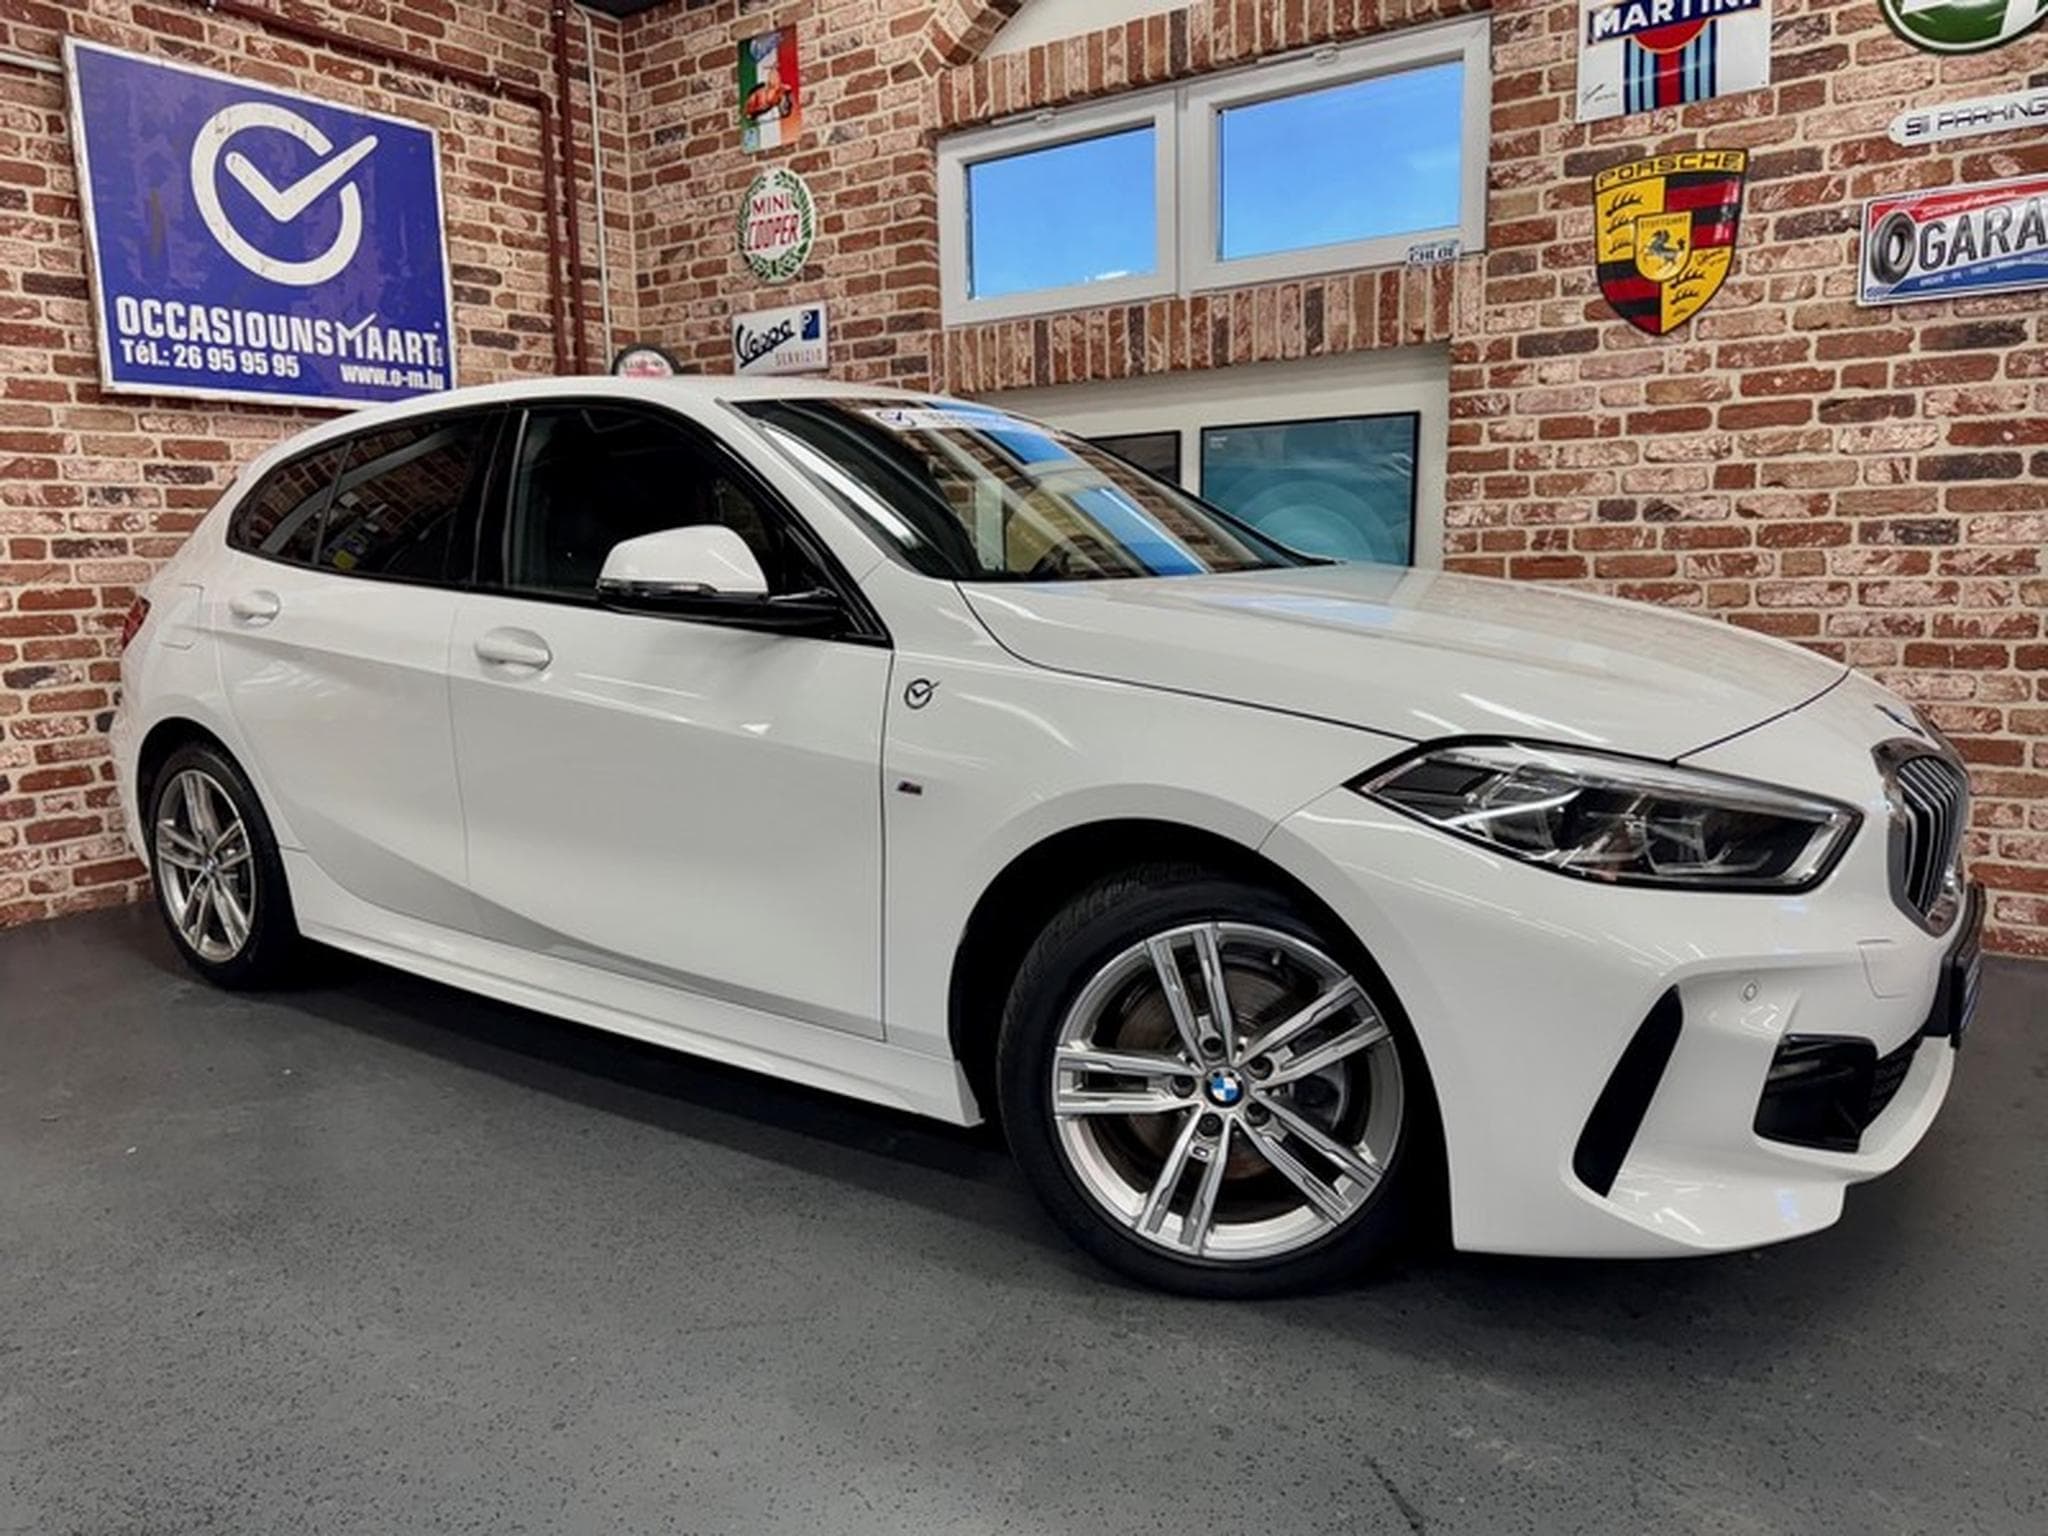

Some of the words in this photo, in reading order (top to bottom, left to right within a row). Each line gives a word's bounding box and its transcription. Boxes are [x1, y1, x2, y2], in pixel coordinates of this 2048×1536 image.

[1593, 0, 1752, 38] MARTI
[1599, 153, 1740, 188] PORSCHE
[752, 192, 791, 216] MINI
[746, 213, 800, 251] COOPER
[115, 295, 439, 367] OCCASIOUNSMAART
[735, 322, 796, 369] Vespa
[119, 338, 171, 367] Tél.:
[173, 343, 204, 371] 26
[206, 346, 237, 373] 95
[240, 350, 269, 376] 95
[272, 353, 301, 379] 95
